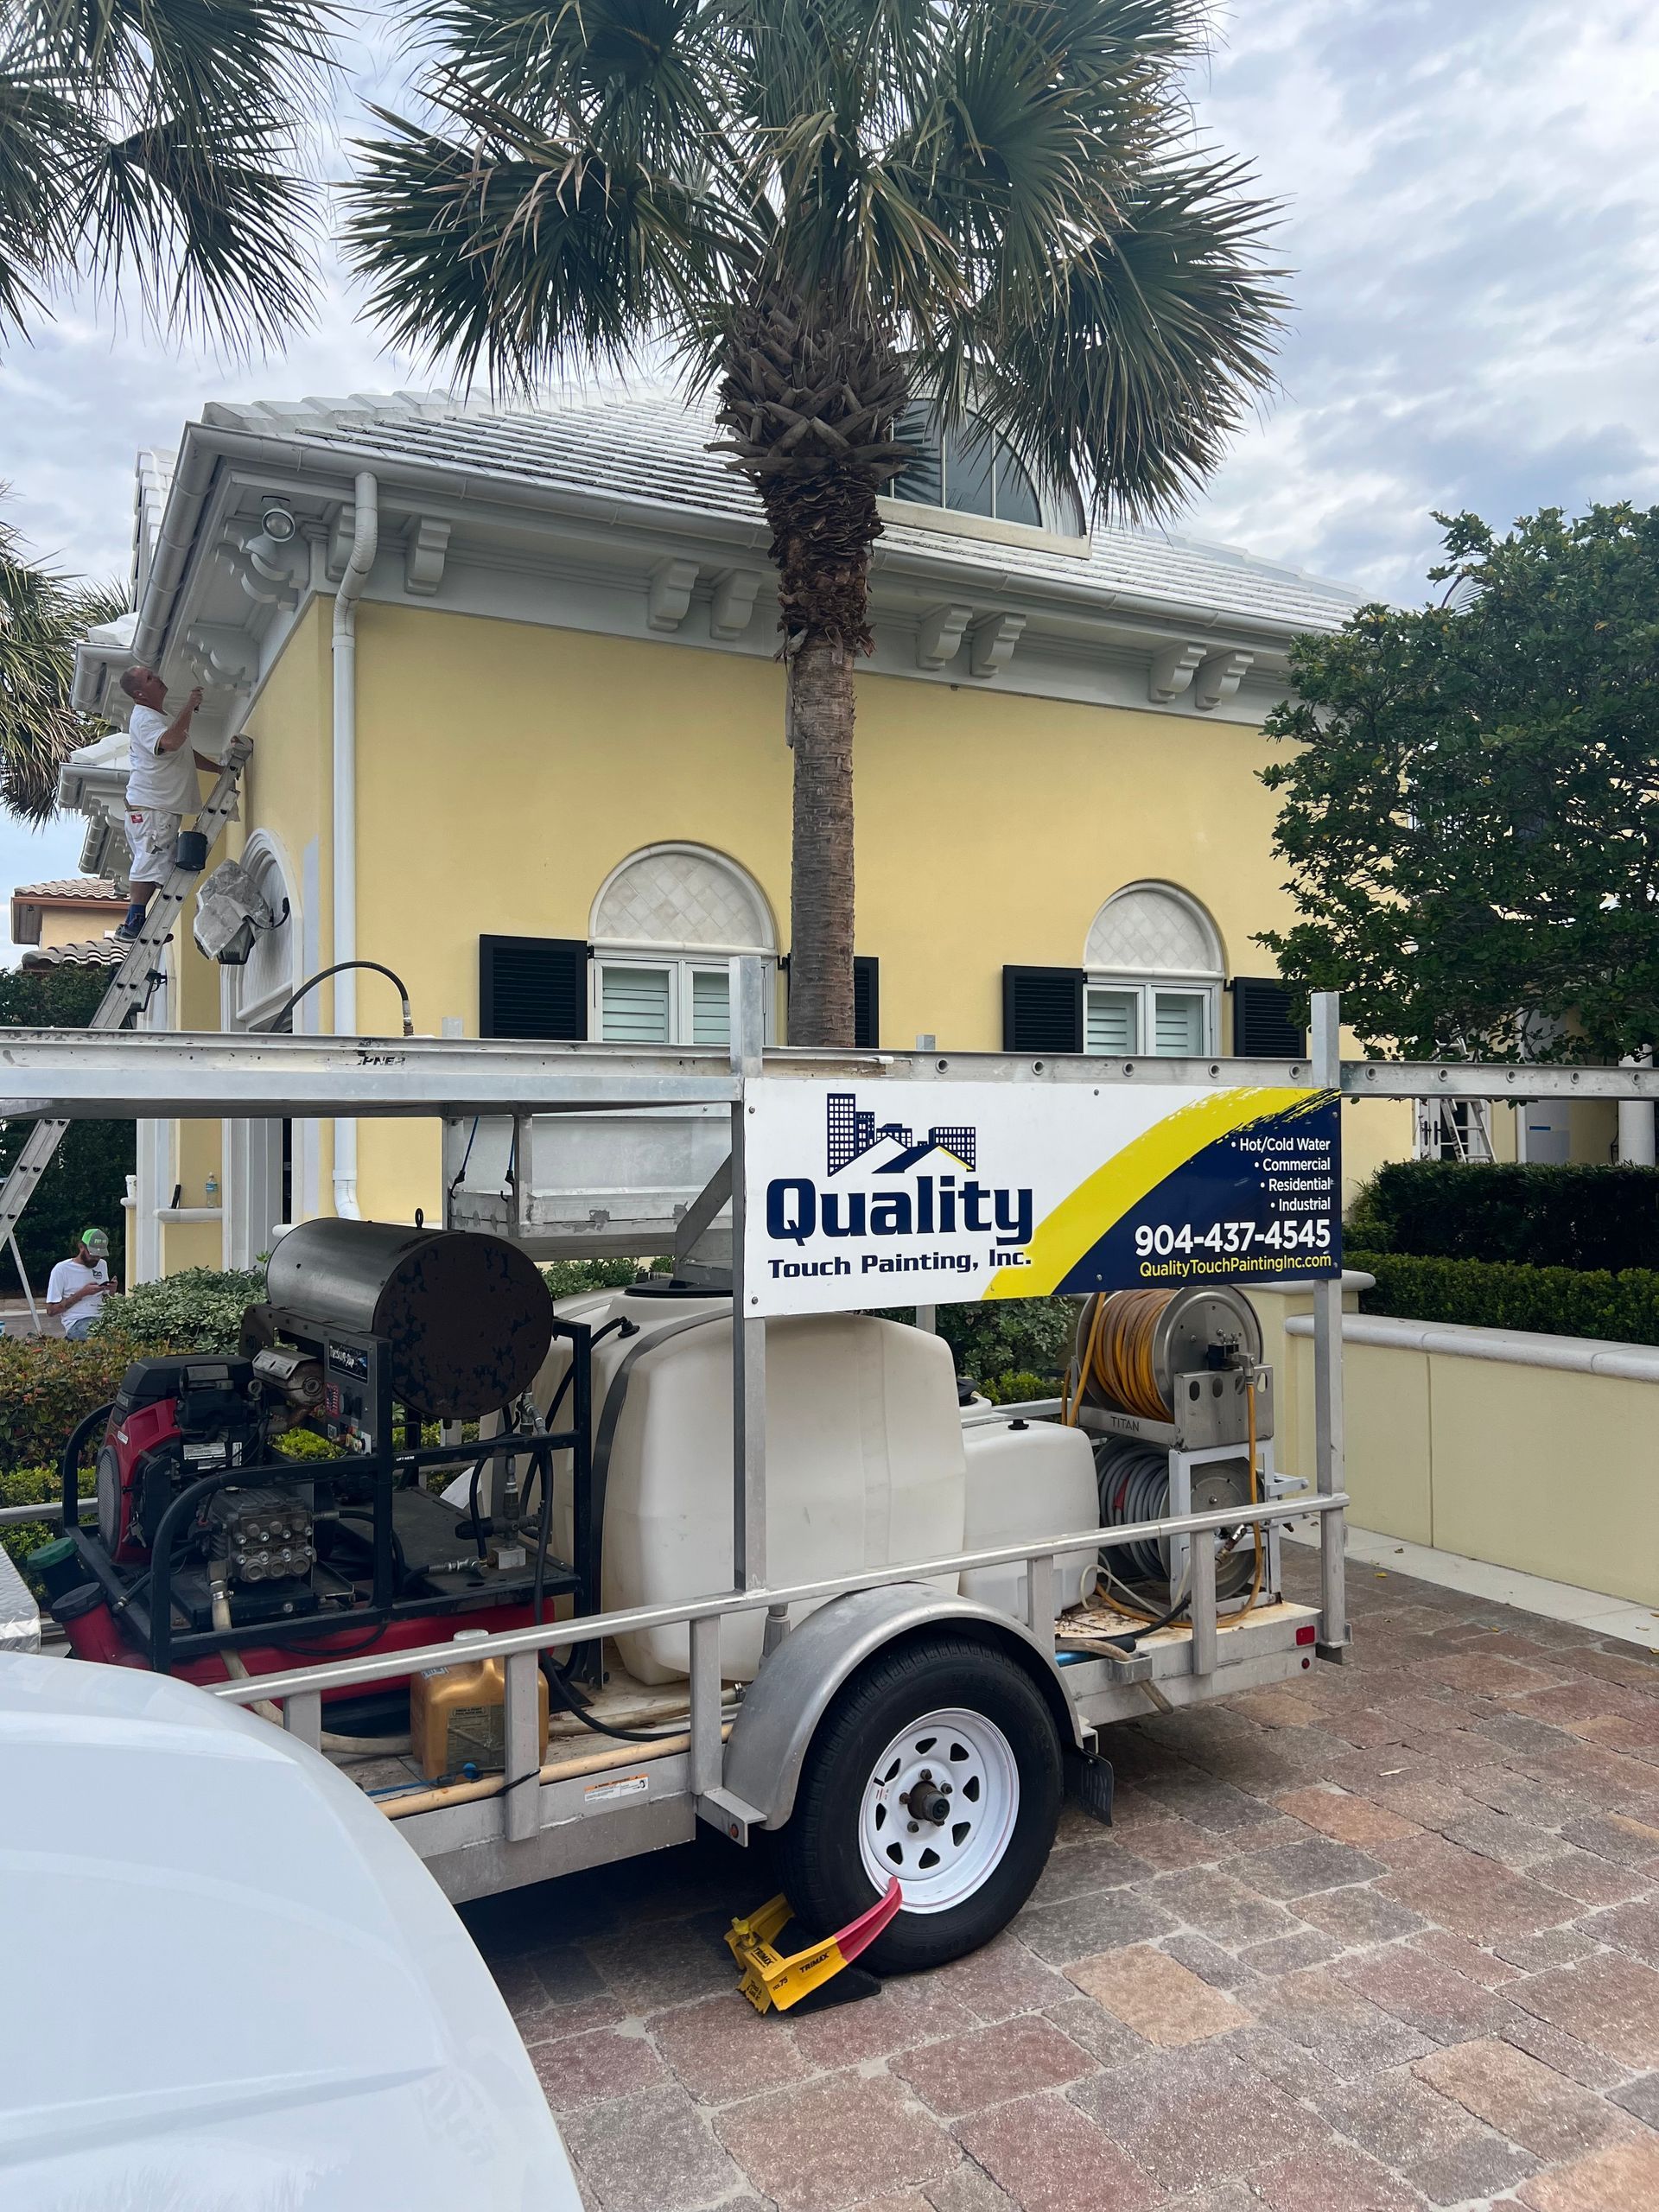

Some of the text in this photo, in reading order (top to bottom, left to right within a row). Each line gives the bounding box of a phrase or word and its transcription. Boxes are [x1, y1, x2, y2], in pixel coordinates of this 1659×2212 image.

[1239, 1135, 1331, 1154] Hot/Cold Water
[1262, 1156, 1331, 1172] Commercial
[1268, 1176, 1331, 1192] Residential
[766, 1175, 1033, 1247] Quality
[1279, 1196, 1331, 1211] Industrial
[1135, 1218, 1331, 1257] 904-437-4545
[767, 1249, 1032, 1279] Touch Painting, Inc.
[1140, 1254, 1332, 1278] QualityTouchPaintingInc.com
[1110, 1416, 1140, 1432] TITAN
[799, 1951, 830, 1974] TRIMAX
